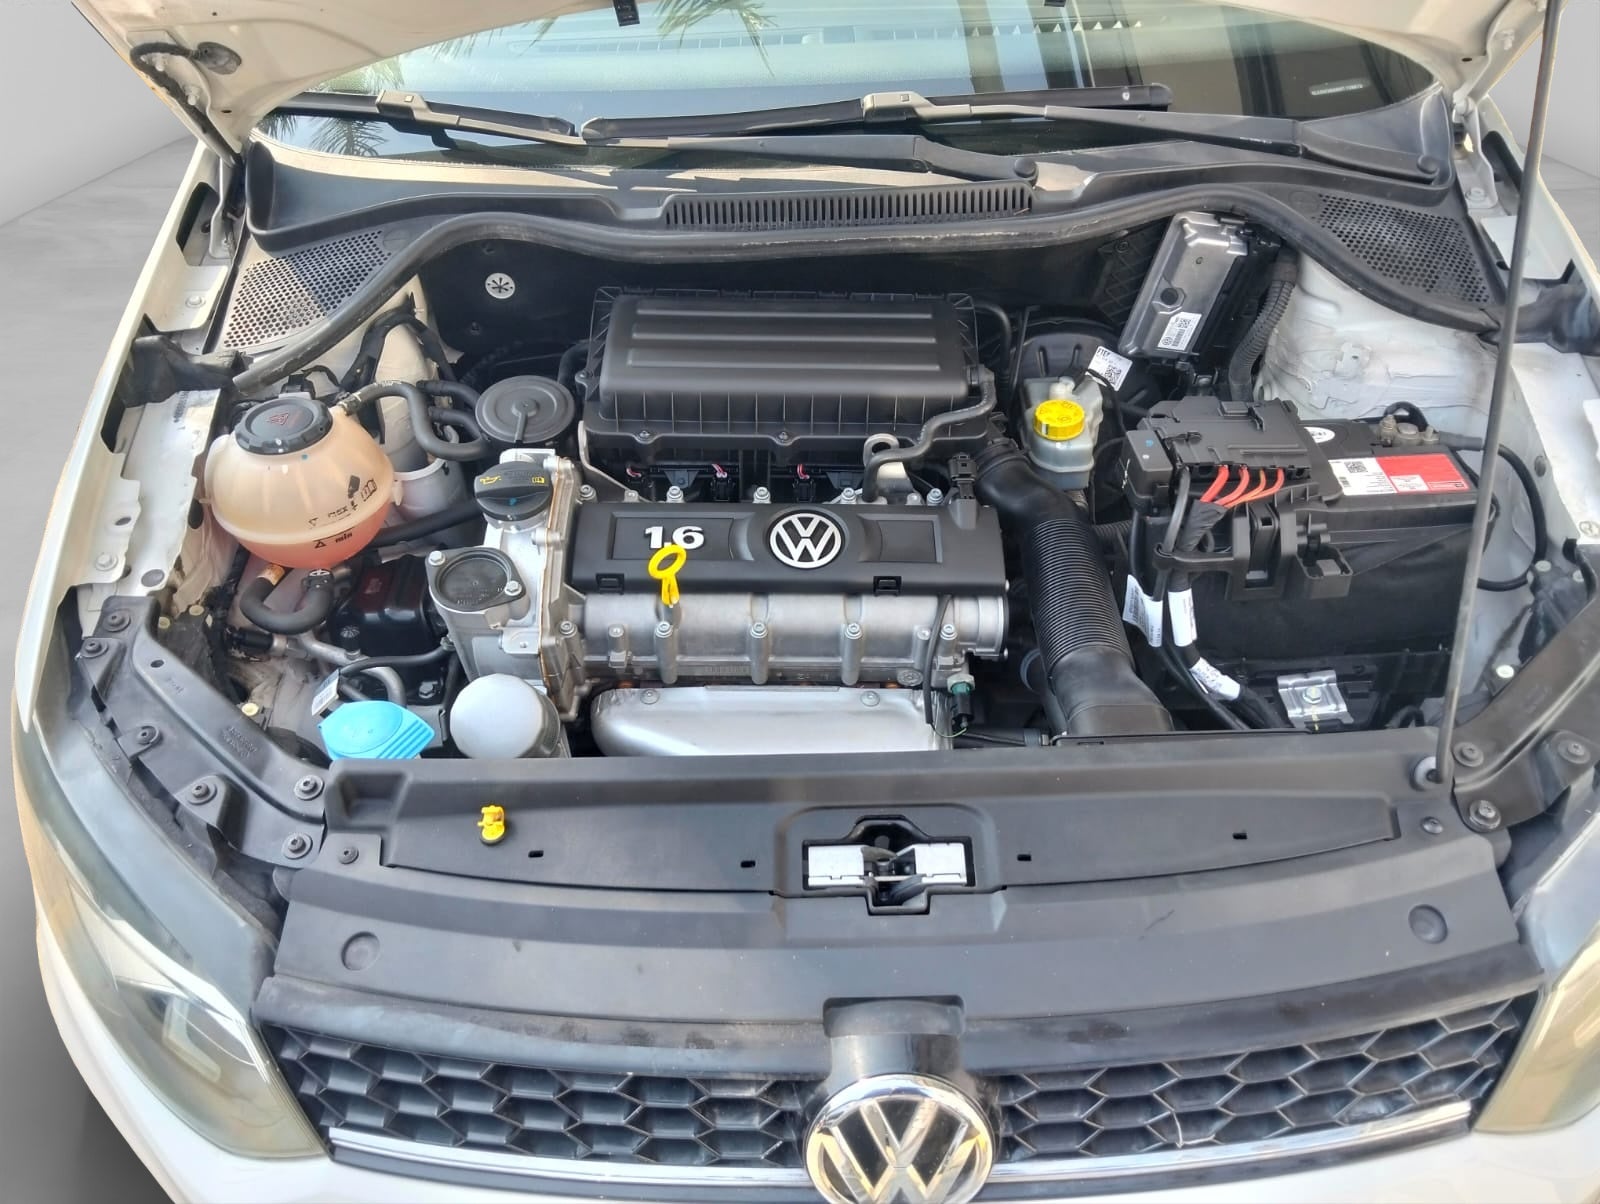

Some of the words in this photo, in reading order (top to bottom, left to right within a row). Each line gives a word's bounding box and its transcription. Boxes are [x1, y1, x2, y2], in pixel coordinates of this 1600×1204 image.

[335, 532, 353, 543] min
[645, 526, 705, 550] 1.6
[770, 513, 842, 569] VW
